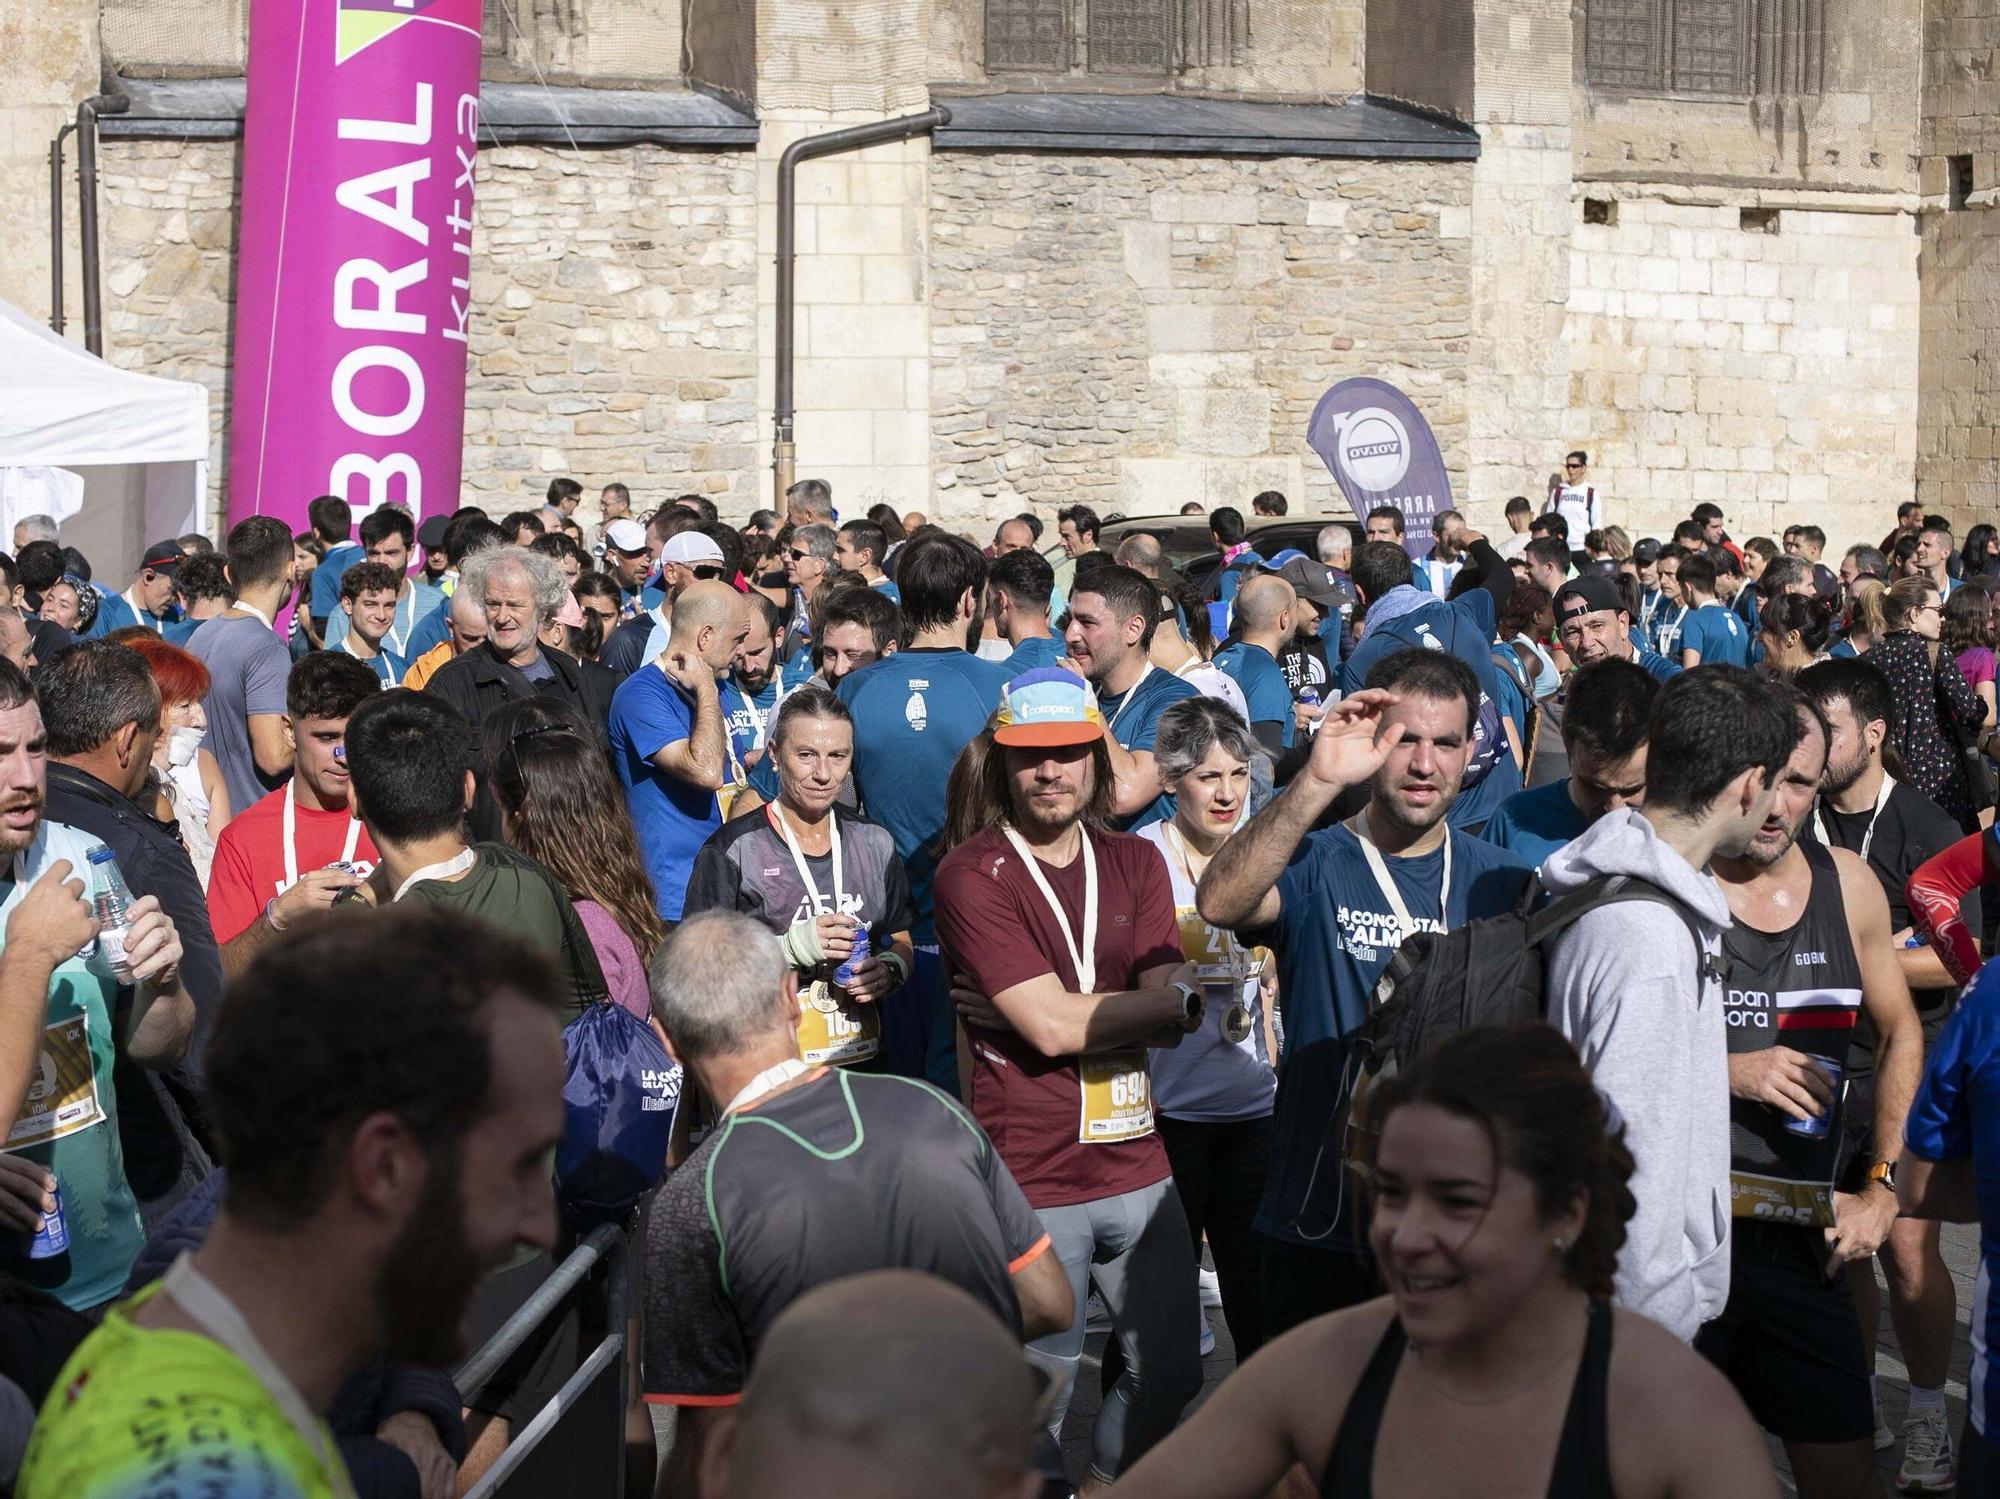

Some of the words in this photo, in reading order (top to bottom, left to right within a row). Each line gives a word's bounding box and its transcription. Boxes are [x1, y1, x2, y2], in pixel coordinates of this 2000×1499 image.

[330, 83, 432, 567] BORAL
[1350, 909, 1441, 933] CONQSTA
[1351, 925, 1401, 948] ALM
[1111, 1071, 1146, 1107] 694
